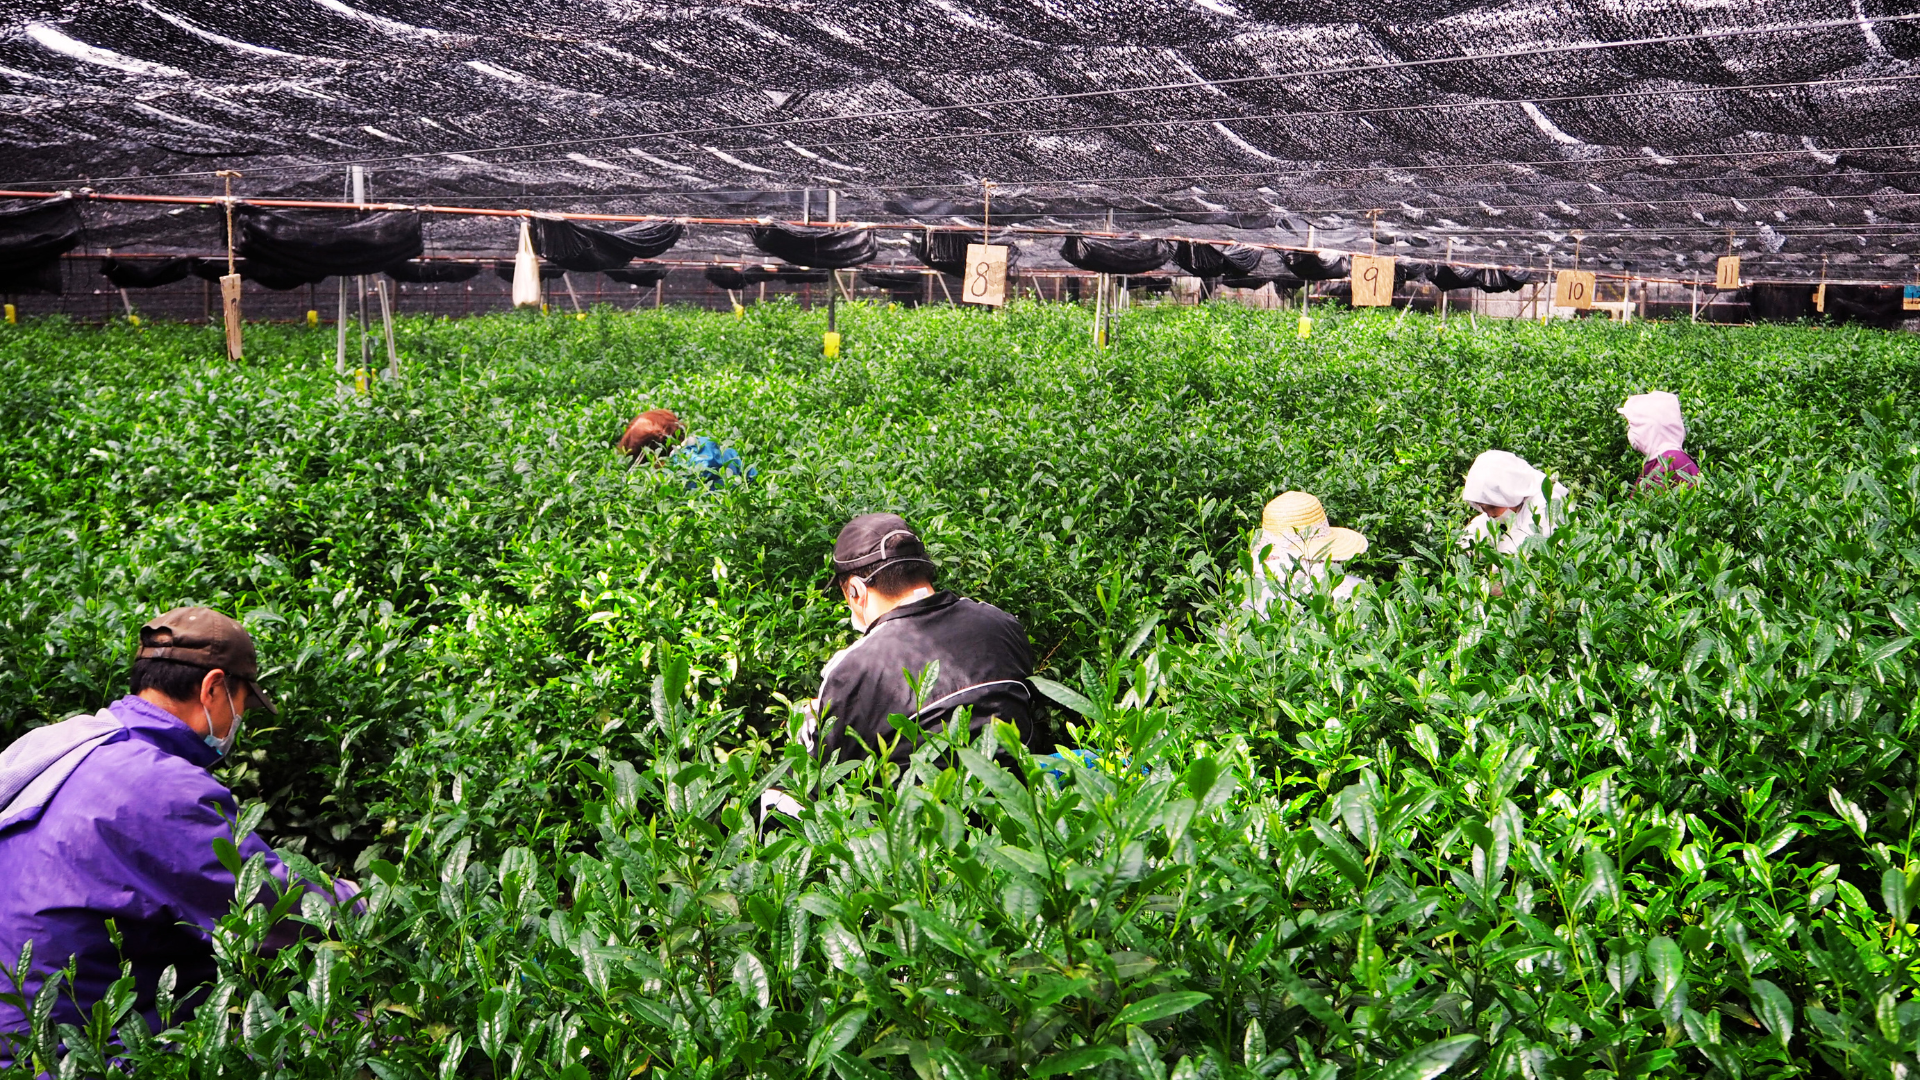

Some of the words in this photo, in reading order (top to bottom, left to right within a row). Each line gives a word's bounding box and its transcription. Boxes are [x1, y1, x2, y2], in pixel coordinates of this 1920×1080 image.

[971, 261, 990, 297] 8
[1363, 266, 1379, 297] 9
[1723, 264, 1734, 285] 11
[1568, 281, 1584, 300] 10
